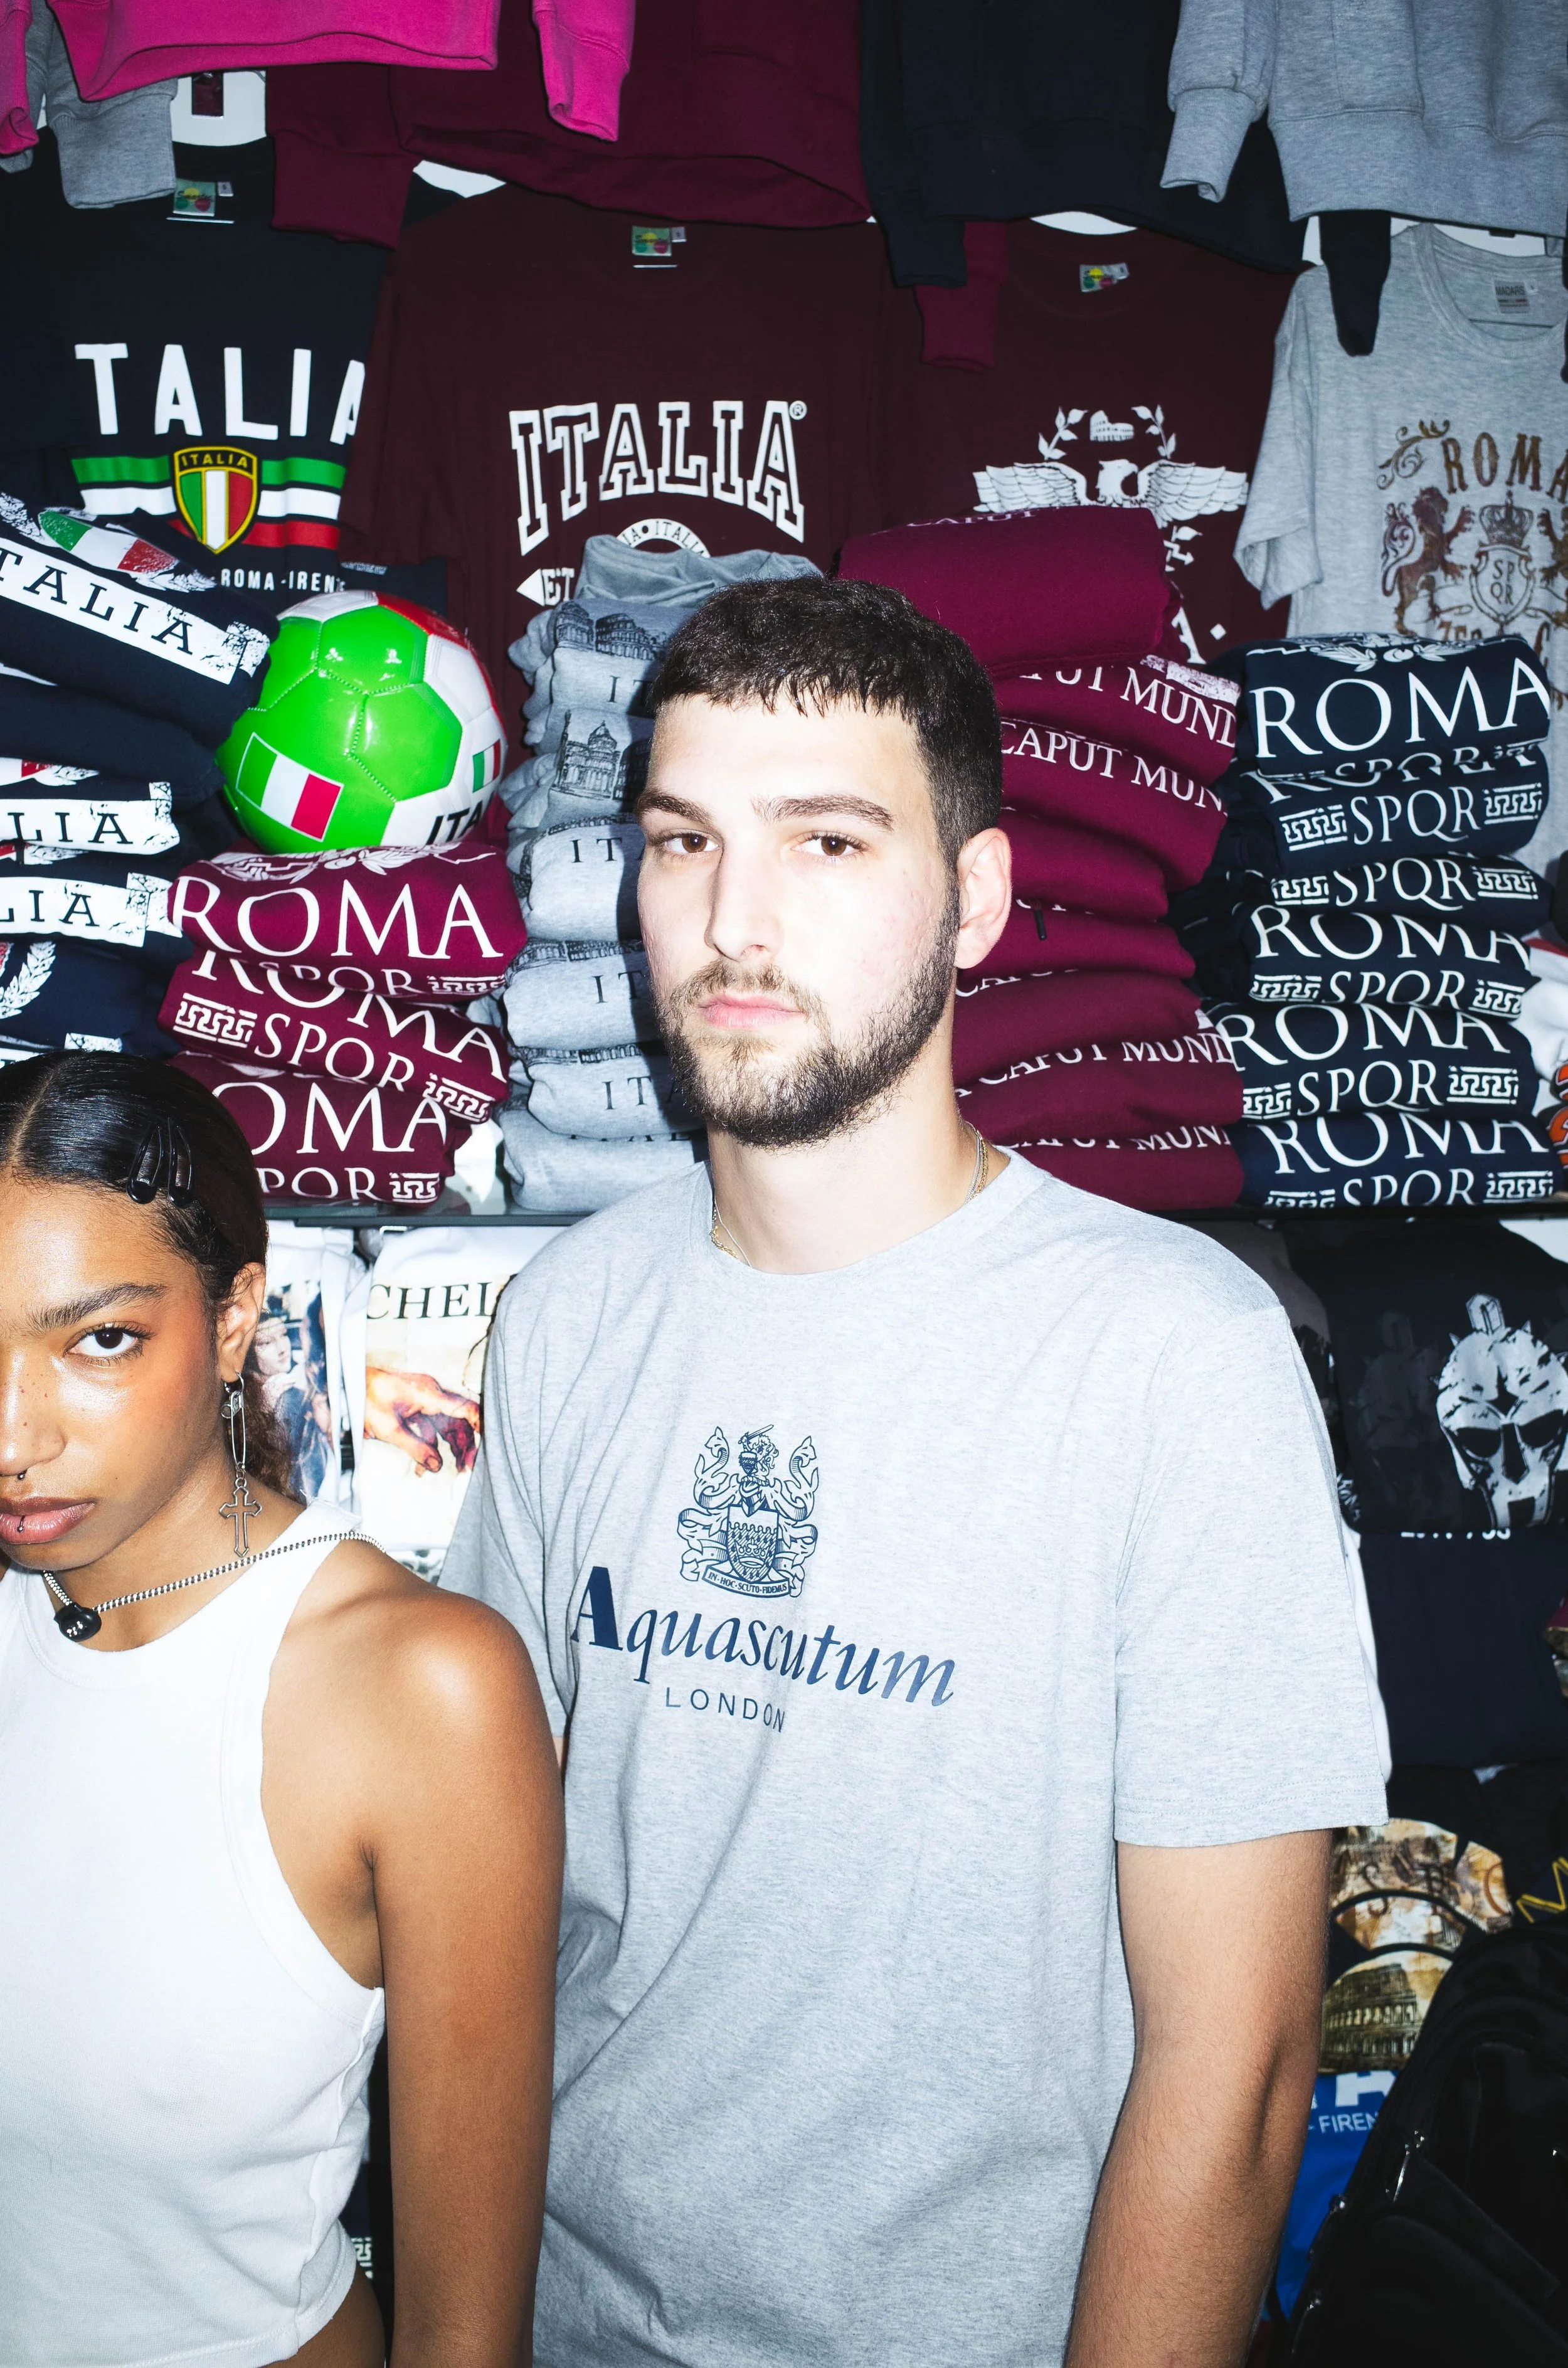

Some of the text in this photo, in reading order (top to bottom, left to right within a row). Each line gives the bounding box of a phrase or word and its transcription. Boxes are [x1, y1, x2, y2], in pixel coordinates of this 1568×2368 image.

[181, 453, 248, 469] ITALIA
[221, 568, 275, 592] ROMA
[1249, 657, 1550, 758] ROMA
[1131, 755, 1228, 817] MUN
[425, 793, 495, 845] ITA
[1350, 786, 1481, 845] SPQR
[1333, 857, 1476, 911] SPQR
[172, 876, 504, 960] ROMA
[1215, 1003, 1511, 1071] ROMA
[1297, 1059, 1445, 1117] SPQR
[1131, 1125, 1231, 1151] MUN
[570, 1566, 956, 1706] Aquascutum
[665, 1687, 785, 1733] LONDON
